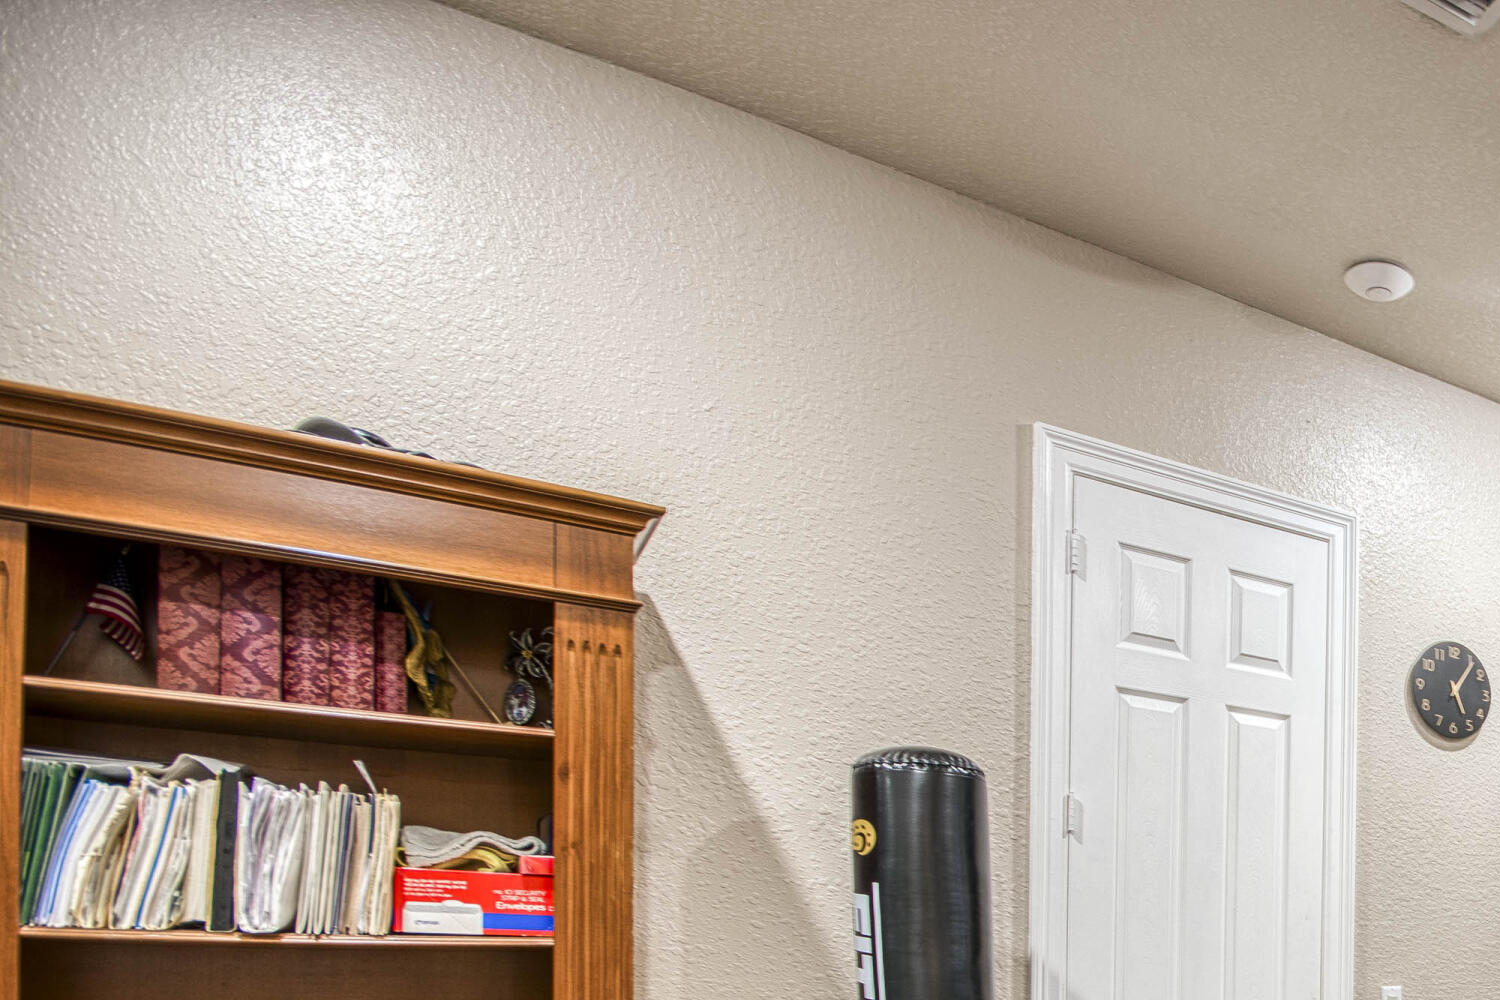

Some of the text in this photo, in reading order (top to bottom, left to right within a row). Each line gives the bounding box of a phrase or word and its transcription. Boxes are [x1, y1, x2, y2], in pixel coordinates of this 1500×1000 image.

[1434, 647, 1444, 660] 11
[1448, 645, 1461, 659] 12
[1422, 658, 1435, 671] 10
[1475, 668, 1485, 681] 2
[1415, 677, 1425, 690] 9
[1482, 689, 1490, 702] 3
[1421, 698, 1430, 711] 8
[1434, 713, 1443, 726] 7
[1475, 708, 1484, 719] 4
[1448, 721, 1458, 733] 6
[1465, 719, 1474, 731] 5
